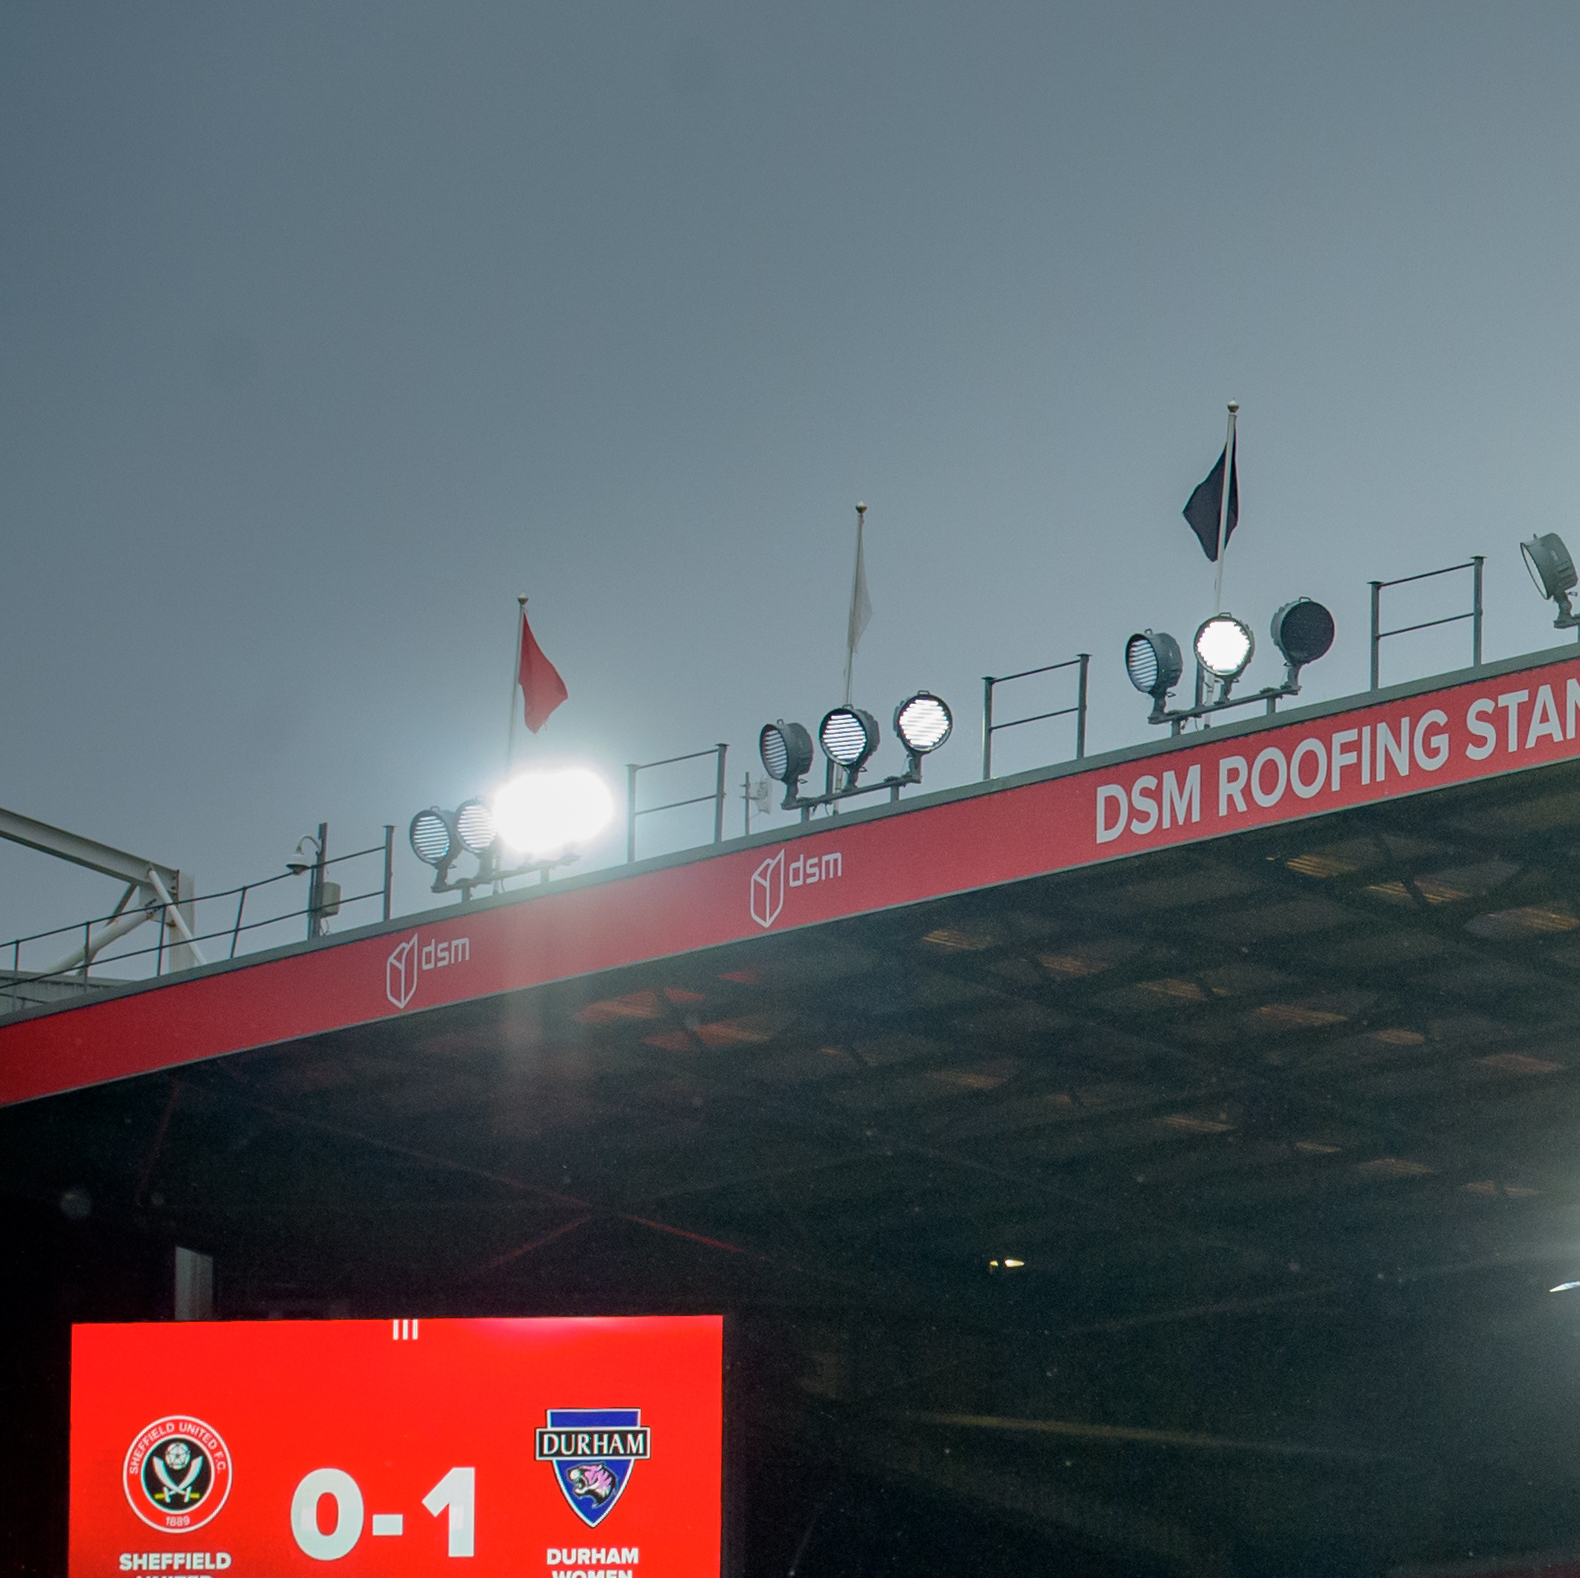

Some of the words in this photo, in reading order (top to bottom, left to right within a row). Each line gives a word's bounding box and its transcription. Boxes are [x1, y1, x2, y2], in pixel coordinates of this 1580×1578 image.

[1096, 765, 1200, 844] DSM
[1219, 709, 1449, 817] ROOFING
[789, 849, 843, 888] dsm
[421, 934, 470, 971] dsm
[130, 1422, 175, 1475] SHEFFIELD
[179, 1422, 218, 1450] UNITED
[213, 1453, 226, 1474] F.C.
[541, 1430, 645, 1458] DURHAM
[166, 1516, 191, 1527] 1889
[119, 1552, 232, 1571] SHEFFIELD
[546, 1547, 640, 1567] DURHAM
